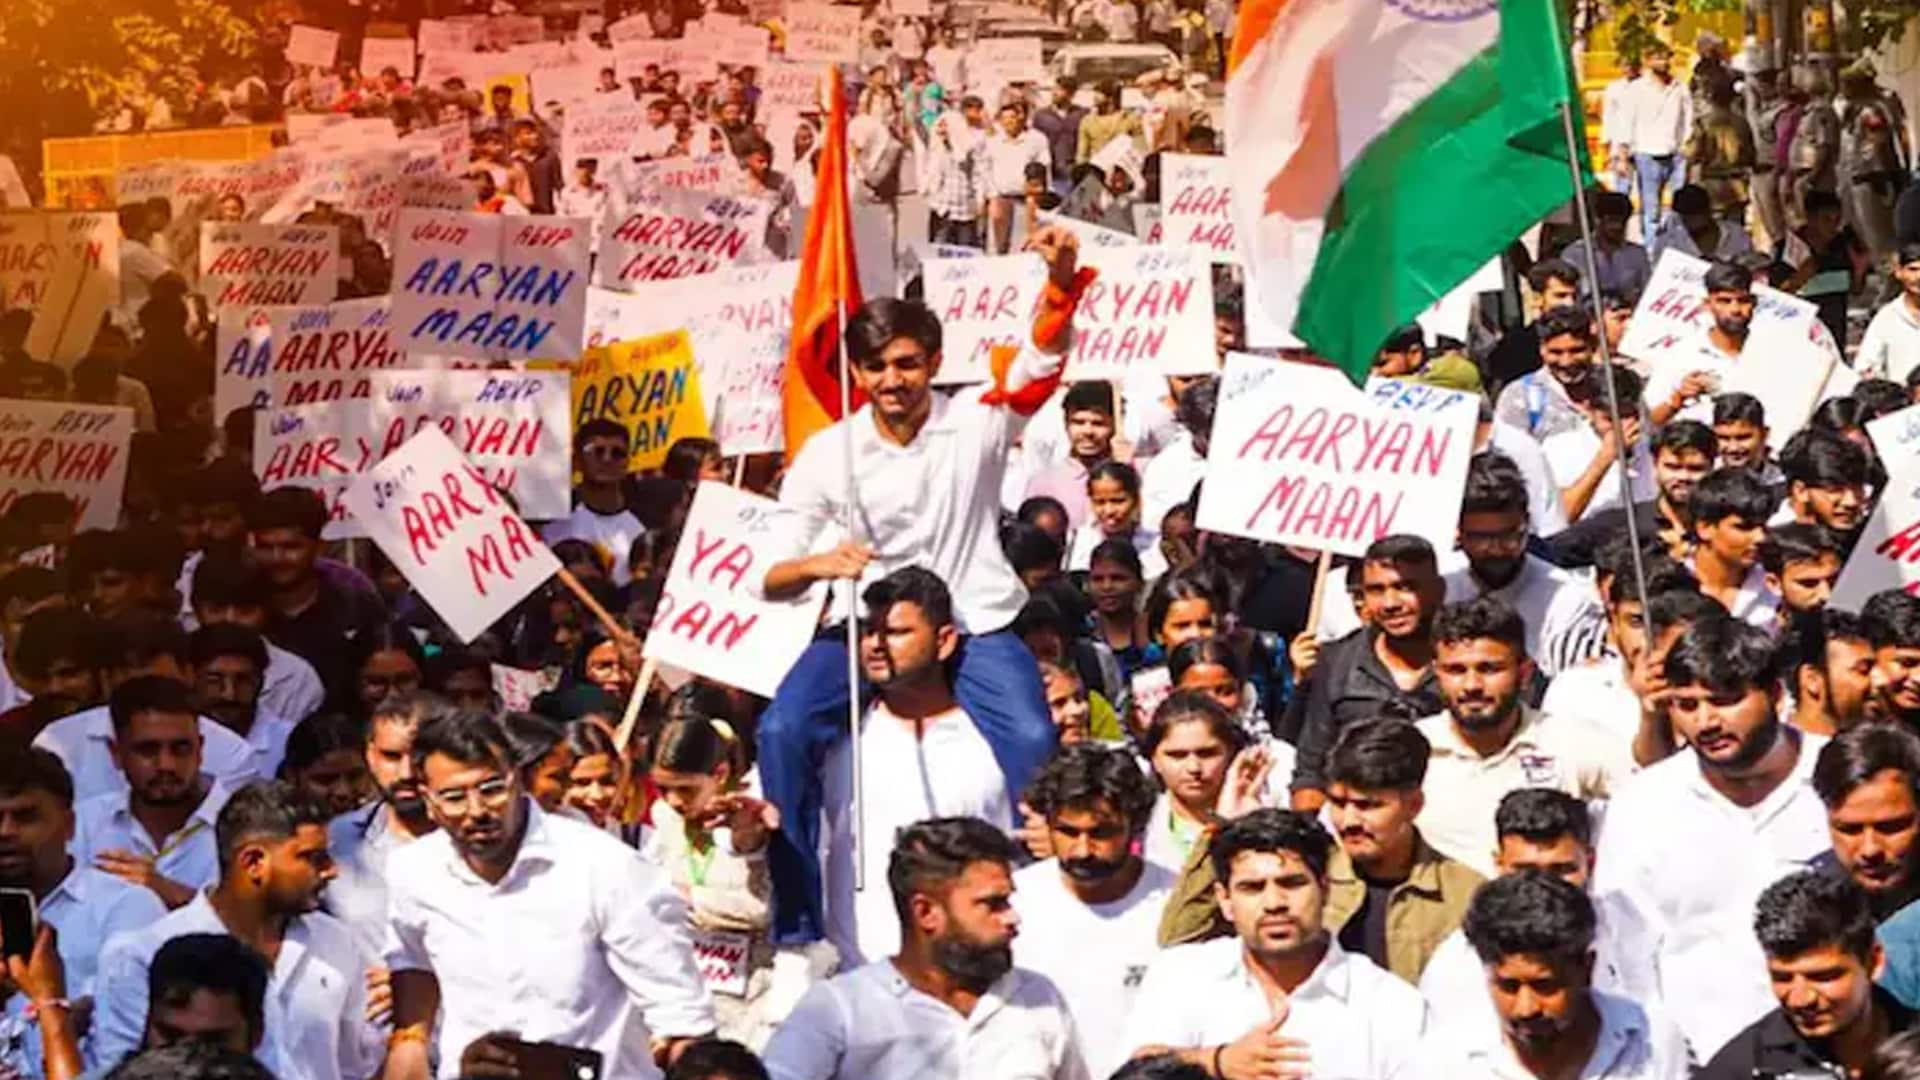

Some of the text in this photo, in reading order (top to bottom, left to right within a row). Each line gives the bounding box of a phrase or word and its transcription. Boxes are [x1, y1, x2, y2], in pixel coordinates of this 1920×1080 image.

[611, 213, 748, 260] AARYAN
[209, 246, 329, 276] AARYAN
[404, 257, 573, 307] AARYAN
[218, 281, 306, 305] MAAN
[410, 307, 556, 352] MAAN
[475, 378, 542, 403] ABVP
[1236, 403, 1454, 478] AARYAN
[1245, 475, 1405, 541] MAAN
[687, 528, 756, 592] YA
